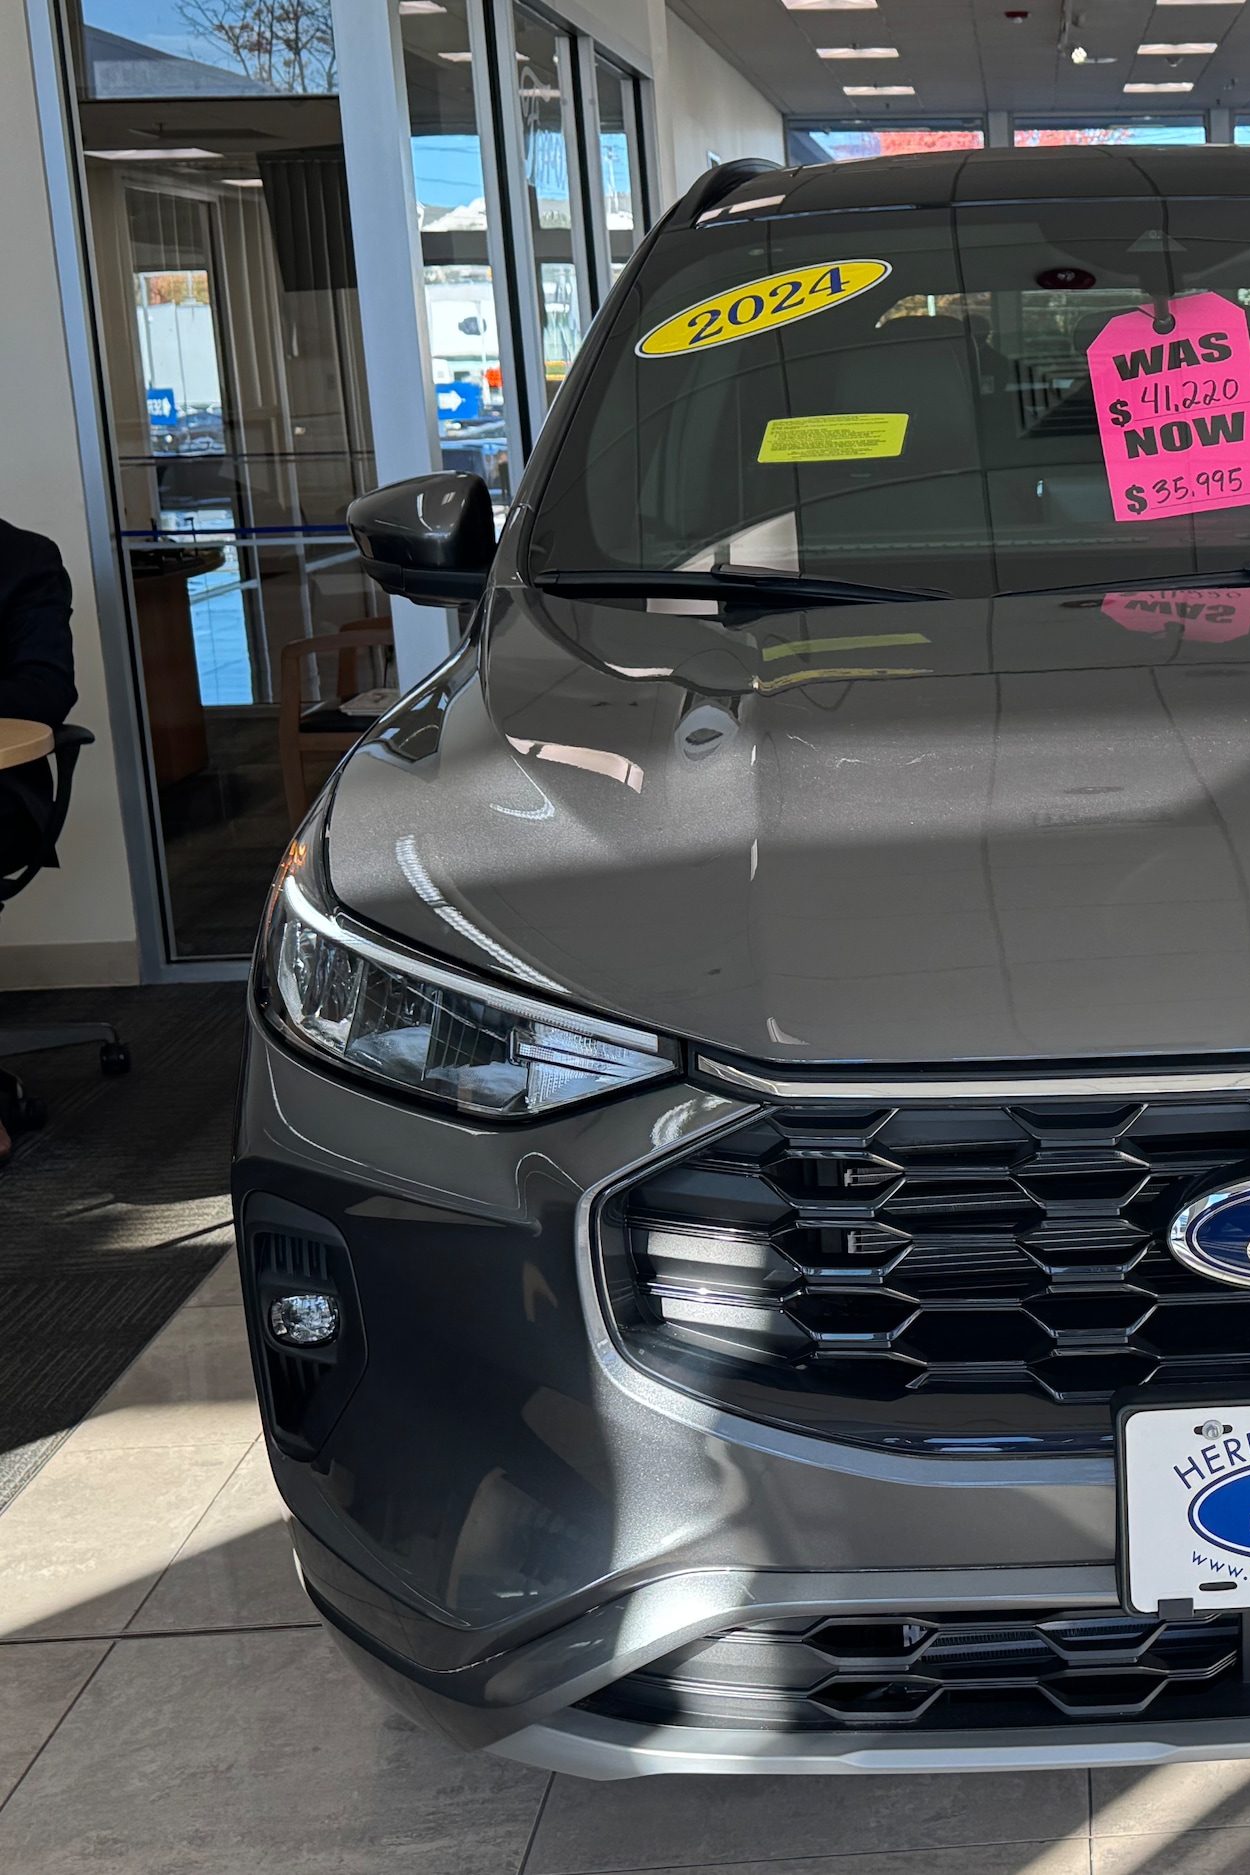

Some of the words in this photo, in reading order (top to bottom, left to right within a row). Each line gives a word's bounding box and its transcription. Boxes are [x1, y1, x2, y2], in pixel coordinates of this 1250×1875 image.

[687, 267, 850, 345] 2024
[1113, 332, 1232, 382] WAS
[1108, 399, 1132, 427] $
[1141, 378, 1239, 414] 41,220
[1124, 411, 1245, 459] NOW
[1125, 485, 1148, 515] $
